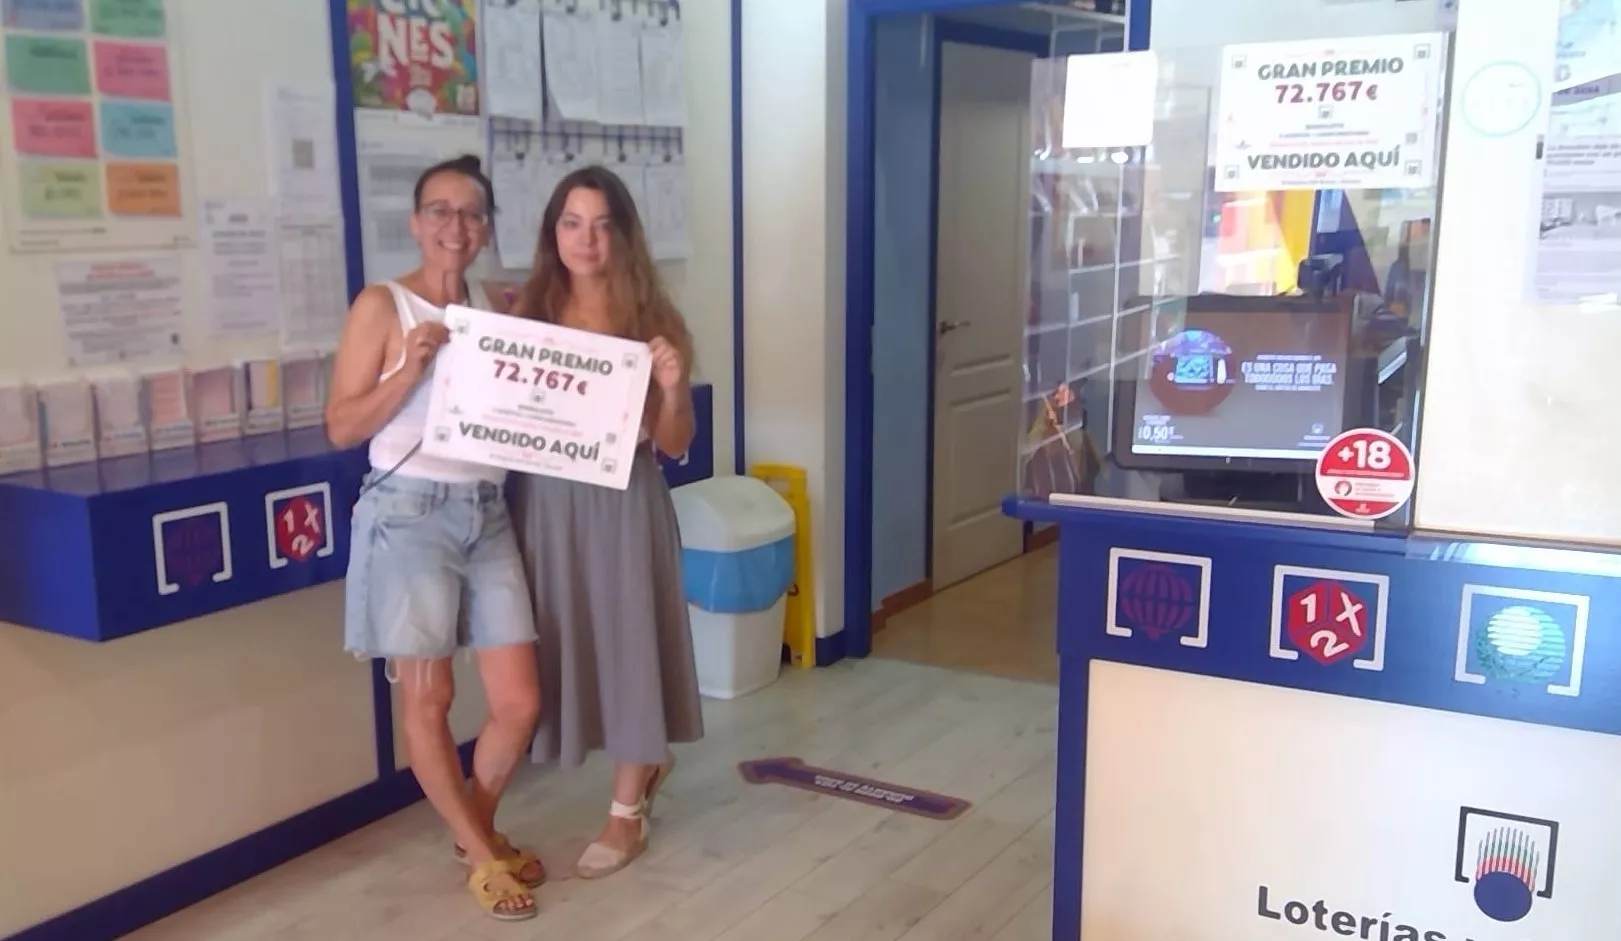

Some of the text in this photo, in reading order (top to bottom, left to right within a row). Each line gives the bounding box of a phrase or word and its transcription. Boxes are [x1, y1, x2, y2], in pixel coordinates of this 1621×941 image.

[1257, 56, 1404, 81] GRAN PREMIO
[1275, 80, 1379, 104] 72.767€
[1247, 144, 1401, 170] VENDIDO AQUÍ
[478, 335, 614, 376] GRAN PREMIO
[459, 420, 547, 452] VENDIDO
[549, 440, 600, 461] AQUÍ
[1337, 439, 1392, 470] +18
